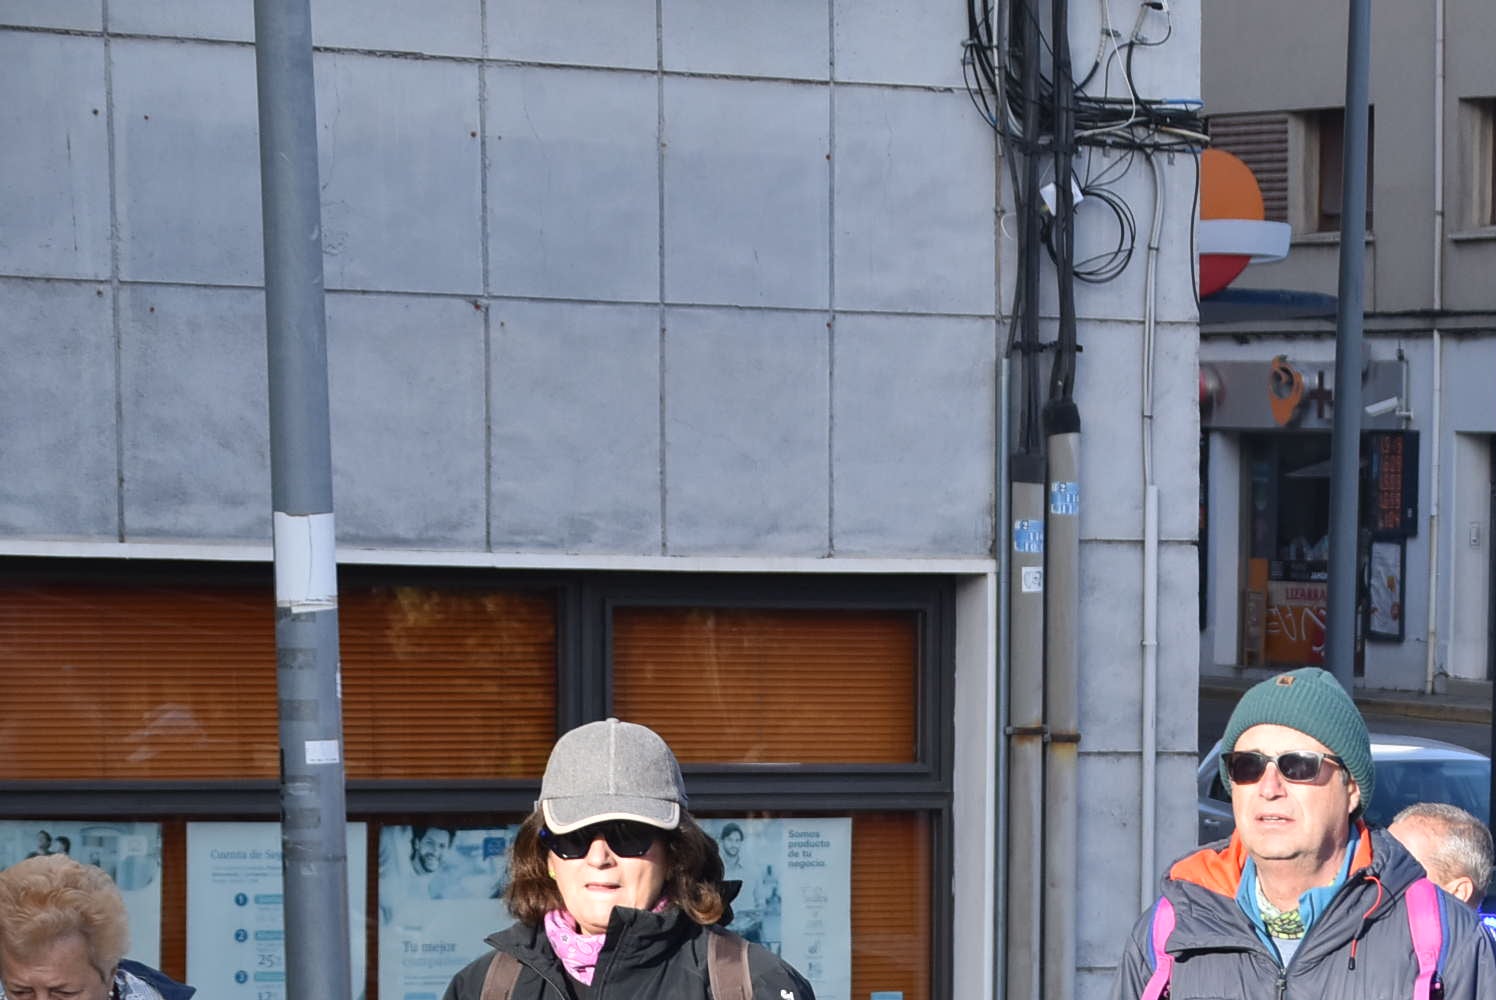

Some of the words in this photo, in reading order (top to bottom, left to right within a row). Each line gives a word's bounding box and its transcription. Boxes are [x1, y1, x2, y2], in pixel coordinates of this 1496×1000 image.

[788, 830, 820, 838] Somos
[787, 840, 831, 848] producto
[787, 849, 799, 858] de
[802, 850, 812, 858] tu
[402, 941, 418, 953] Tu
[422, 940, 457, 954] mejor
